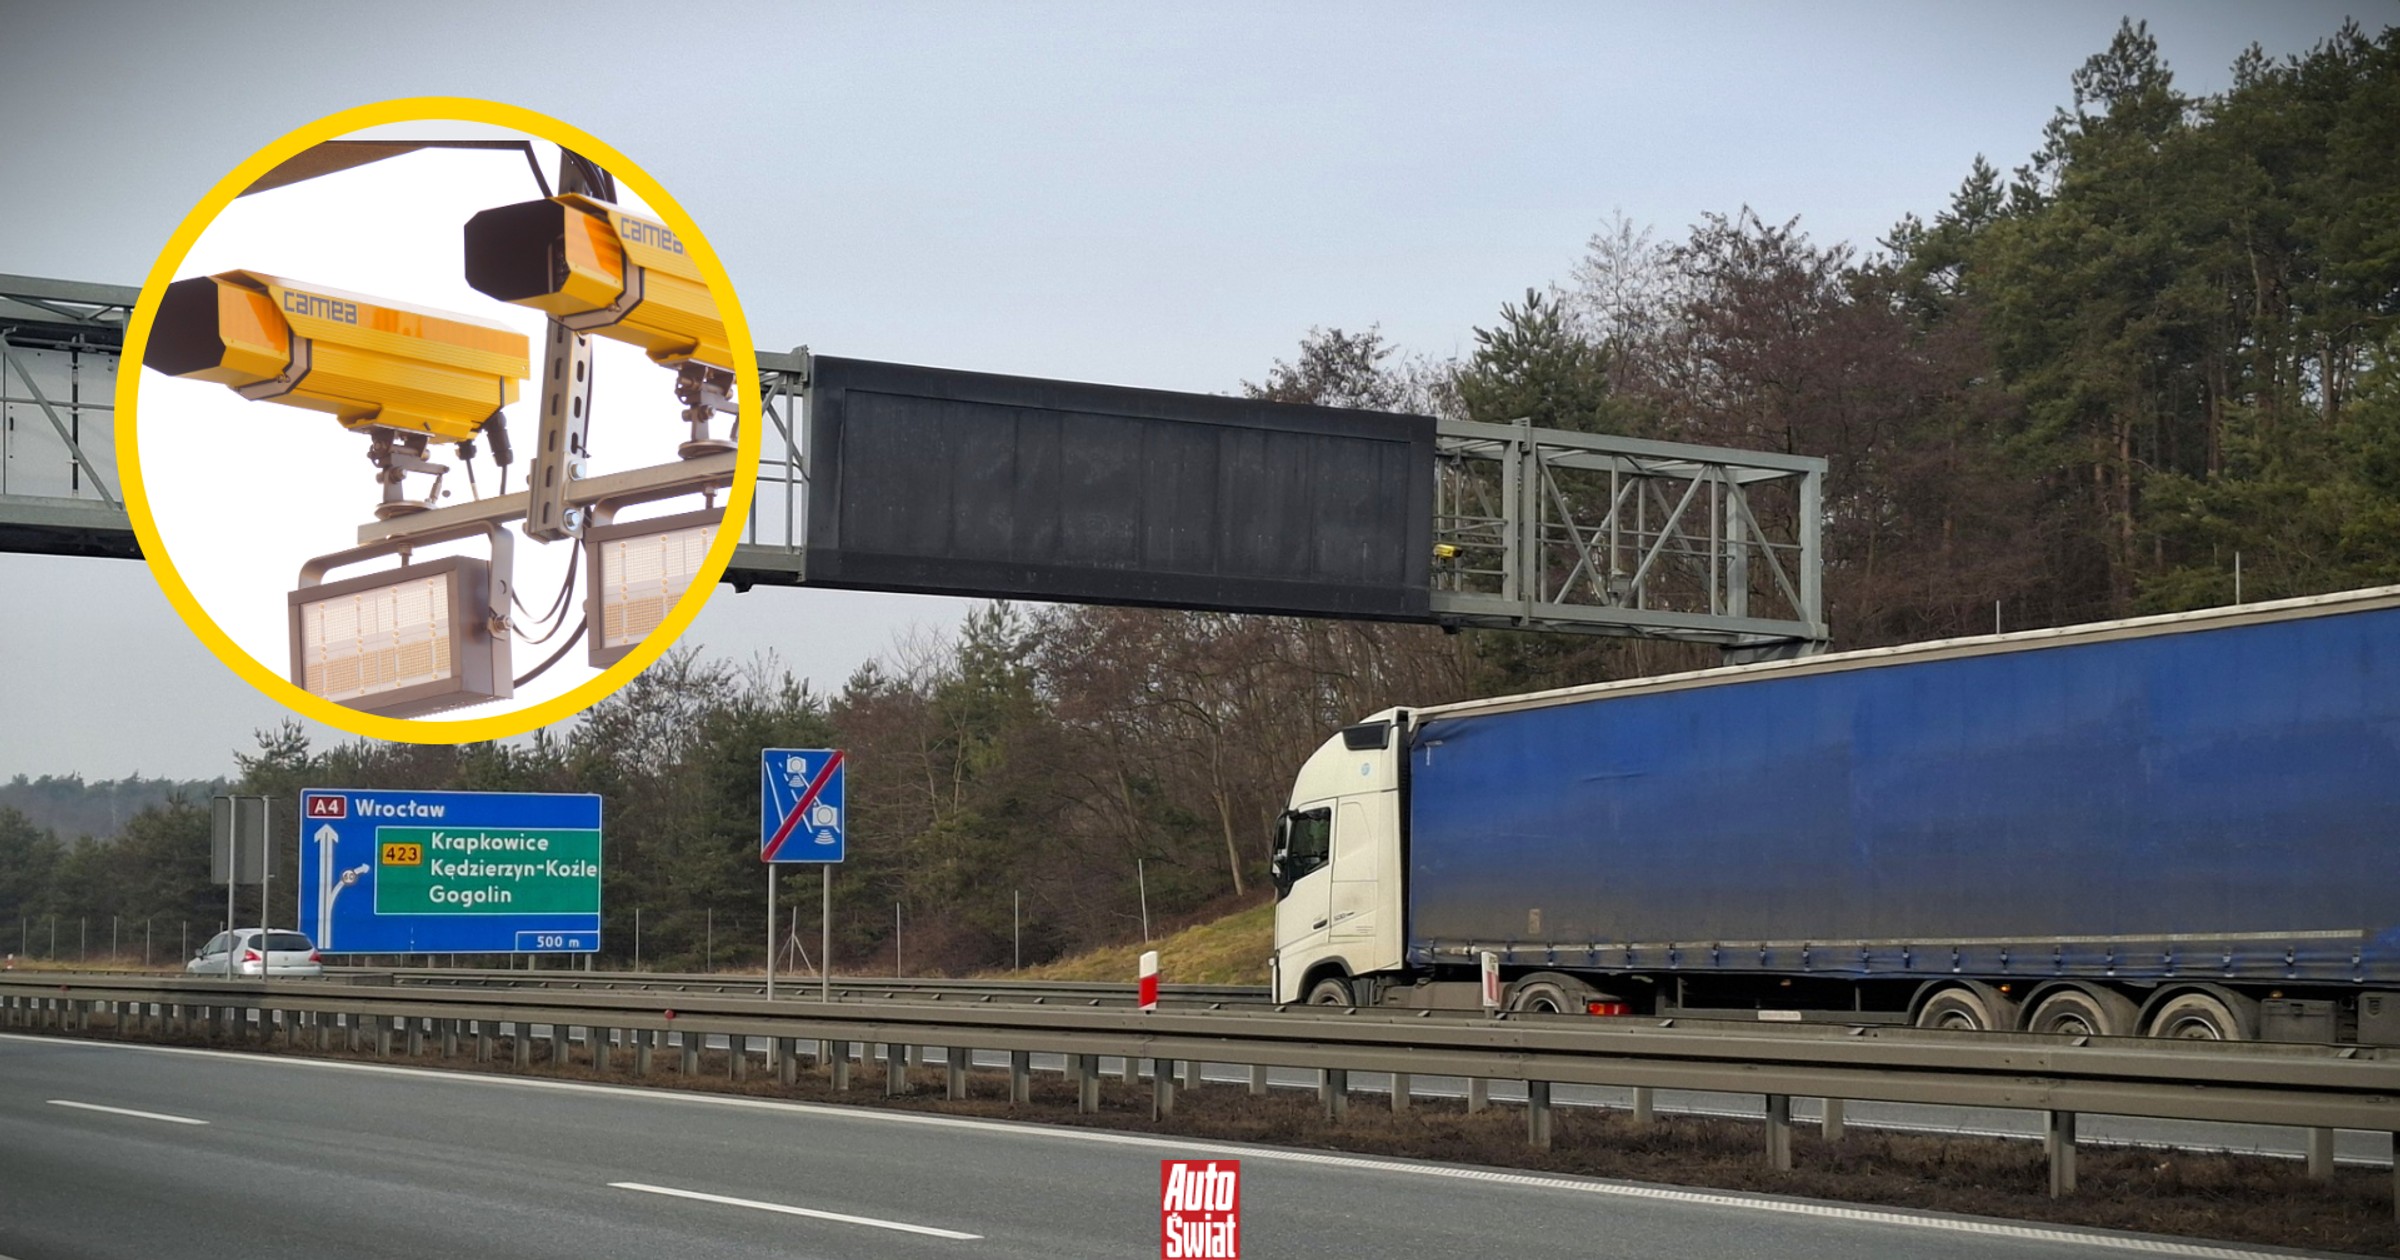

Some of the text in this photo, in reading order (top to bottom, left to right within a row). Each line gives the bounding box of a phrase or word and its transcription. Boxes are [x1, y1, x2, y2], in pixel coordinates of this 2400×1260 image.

[284, 291, 357, 324] camea
[314, 799, 339, 814] A4
[355, 799, 445, 817] Wrocław
[430, 832, 549, 855] Krapkowice
[385, 847, 418, 861] 423
[430, 859, 598, 882] Kędzierzyn-Koźle
[429, 885, 512, 907] Gogolin
[536, 936, 580, 948] 500 m
